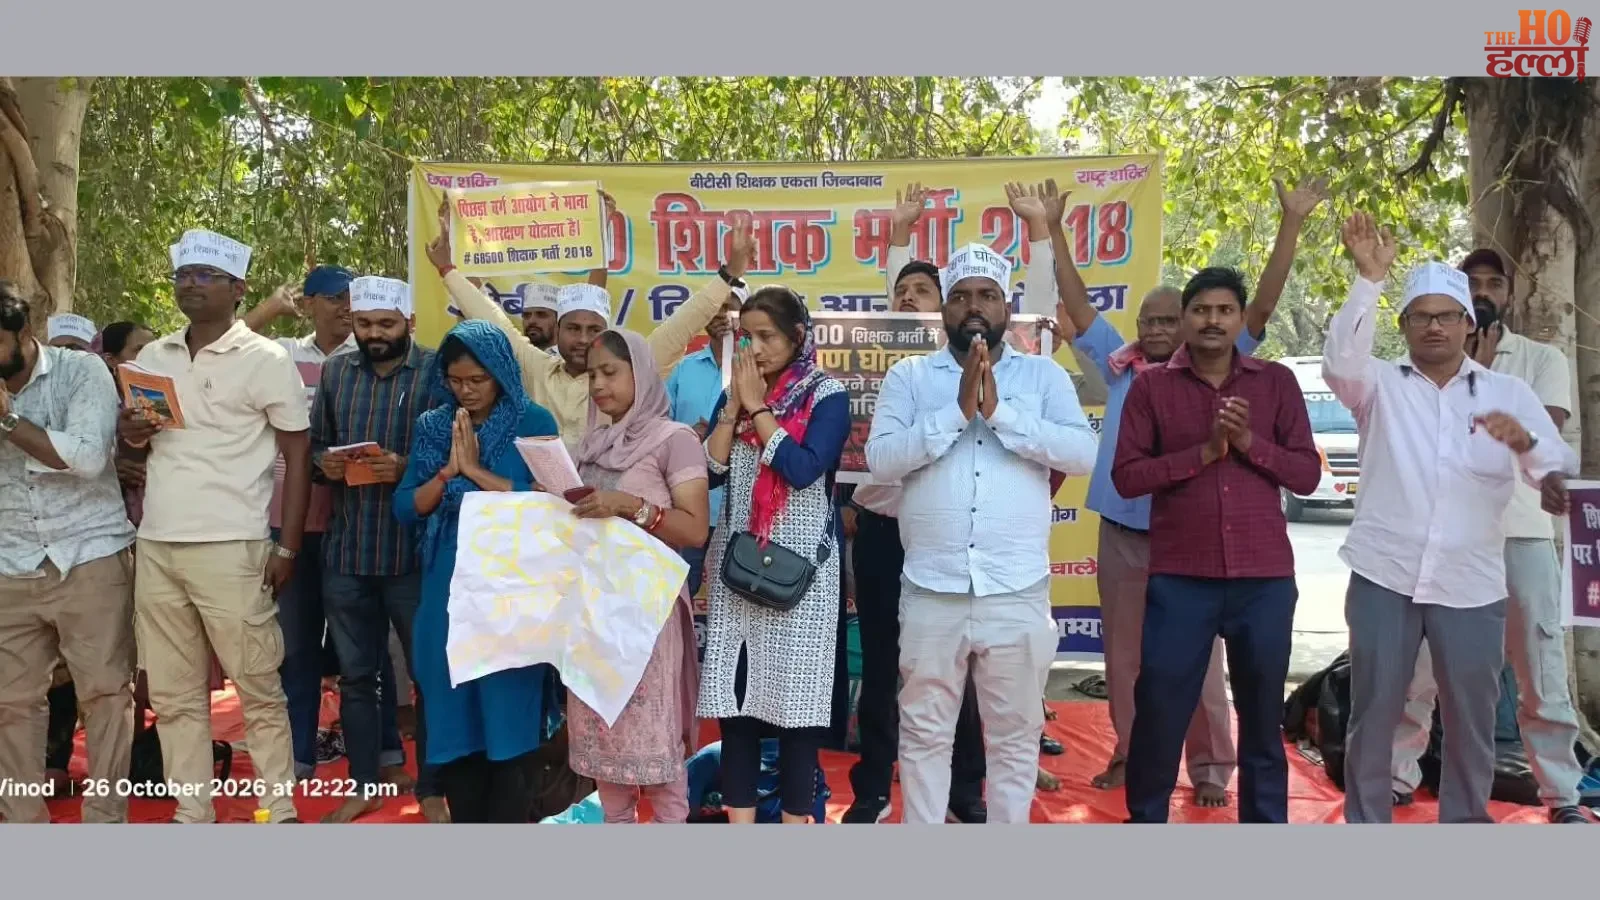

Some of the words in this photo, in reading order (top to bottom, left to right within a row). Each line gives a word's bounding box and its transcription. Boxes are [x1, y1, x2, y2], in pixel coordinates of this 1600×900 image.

[690, 173, 731, 189] बीटीसी
[736, 172, 776, 189] शिक्षक
[781, 175, 817, 188] एकता
[822, 171, 883, 188] जिन्दाबाद
[1076, 170, 1107, 188] राष्ट्र
[458, 199, 488, 221] पिछड़ा
[511, 193, 546, 214] आयोग
[549, 192, 560, 211] ने
[562, 194, 588, 210] माना
[484, 226, 525, 242] आरक्षण
[464, 252, 471, 265] #
[474, 251, 504, 265] 68500
[507, 247, 538, 263] शिक्षक
[564, 246, 593, 259] 2018
[851, 326, 895, 344] शिक्षक
[897, 326, 925, 344] भर्ती
[1572, 543, 1593, 565] पर
